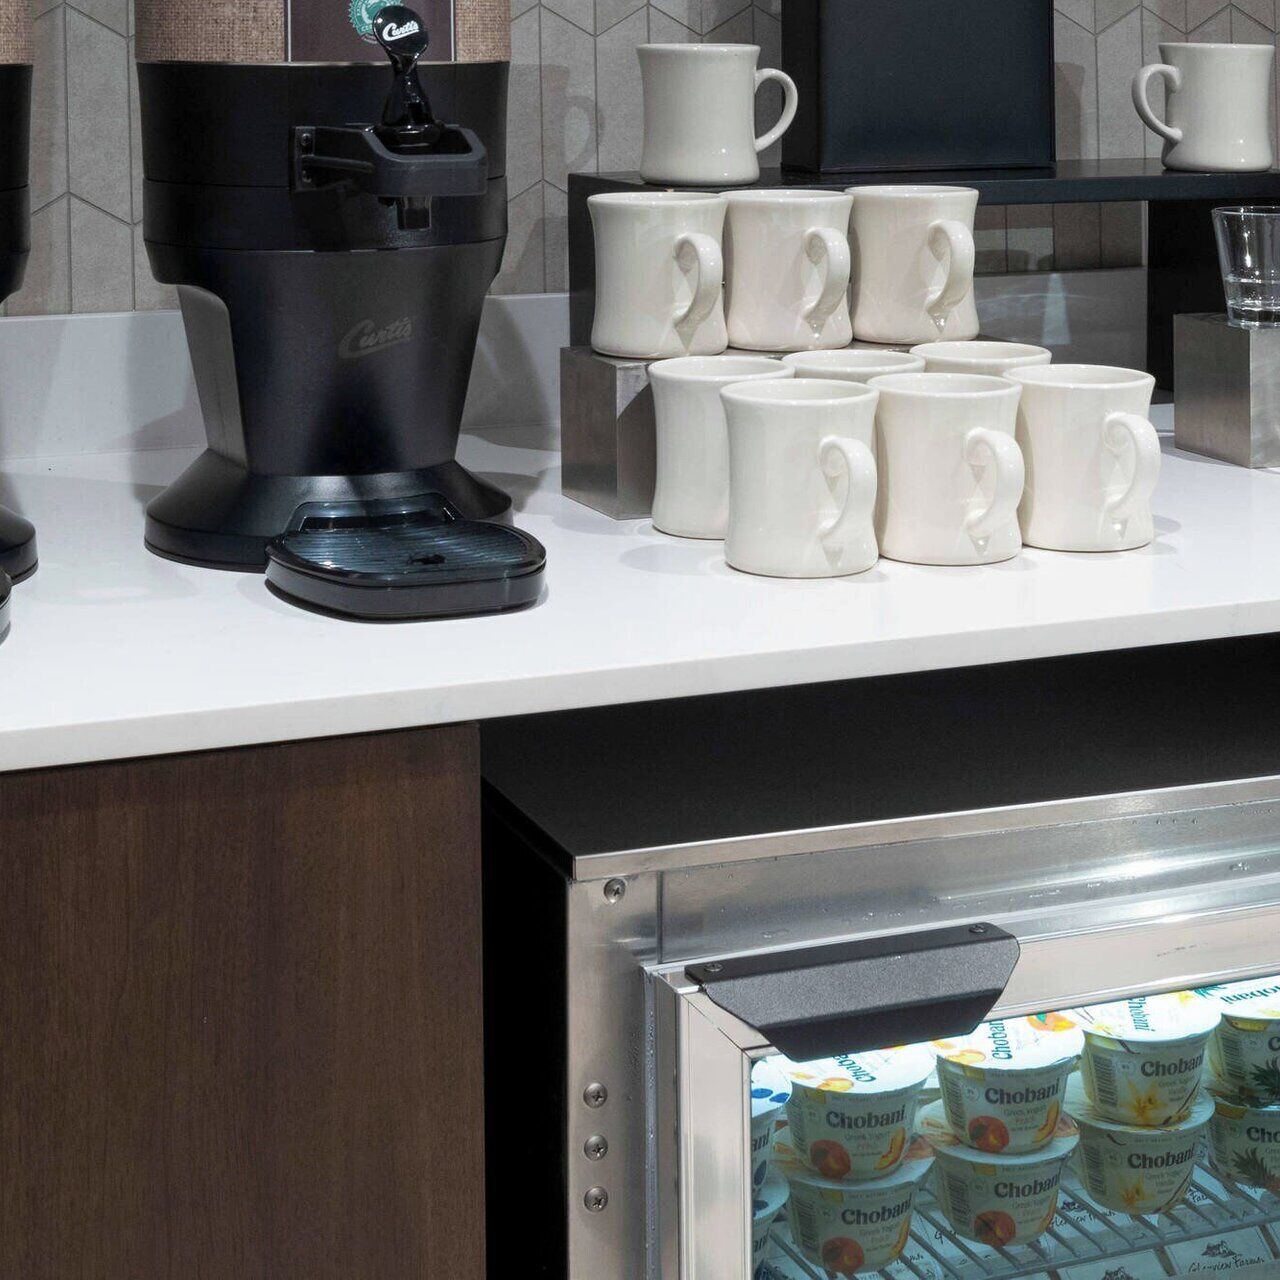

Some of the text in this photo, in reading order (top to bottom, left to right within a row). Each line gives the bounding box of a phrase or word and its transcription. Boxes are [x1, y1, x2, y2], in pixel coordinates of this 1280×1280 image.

[382, 20, 420, 41] Curtis
[337, 316, 414, 359] Curtis
[984, 1077, 1060, 1105] Chobani
[825, 1103, 906, 1130] Chobani
[1127, 1142, 1196, 1169] Chobani
[841, 1192, 913, 1226] Chobani
